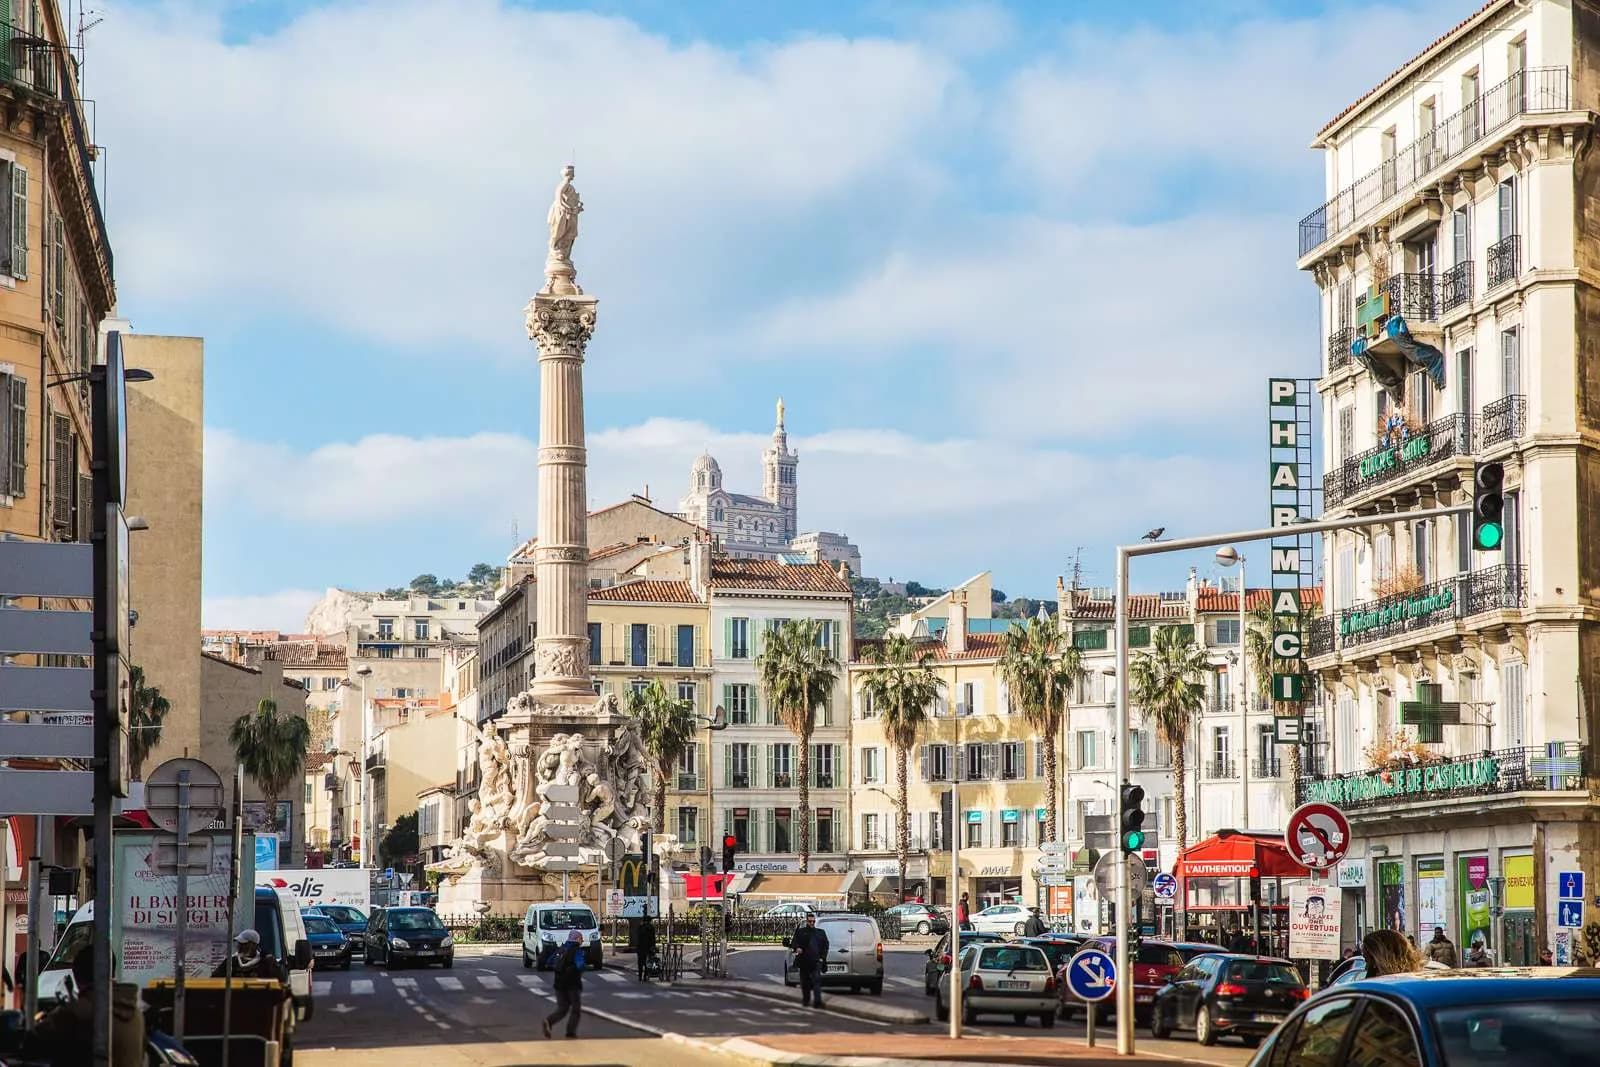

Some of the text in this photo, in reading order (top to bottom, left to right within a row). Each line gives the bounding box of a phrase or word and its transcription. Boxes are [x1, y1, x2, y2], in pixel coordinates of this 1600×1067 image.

[1272, 381, 1300, 740] PHARMACIE
[1406, 768, 1422, 793] DE
[1424, 757, 1498, 792] CASTELLANE
[130, 896, 231, 909] IL BABIER
[134, 911, 230, 923] DI SIIGLIA
[1292, 923, 1339, 932] OUVERTURE
